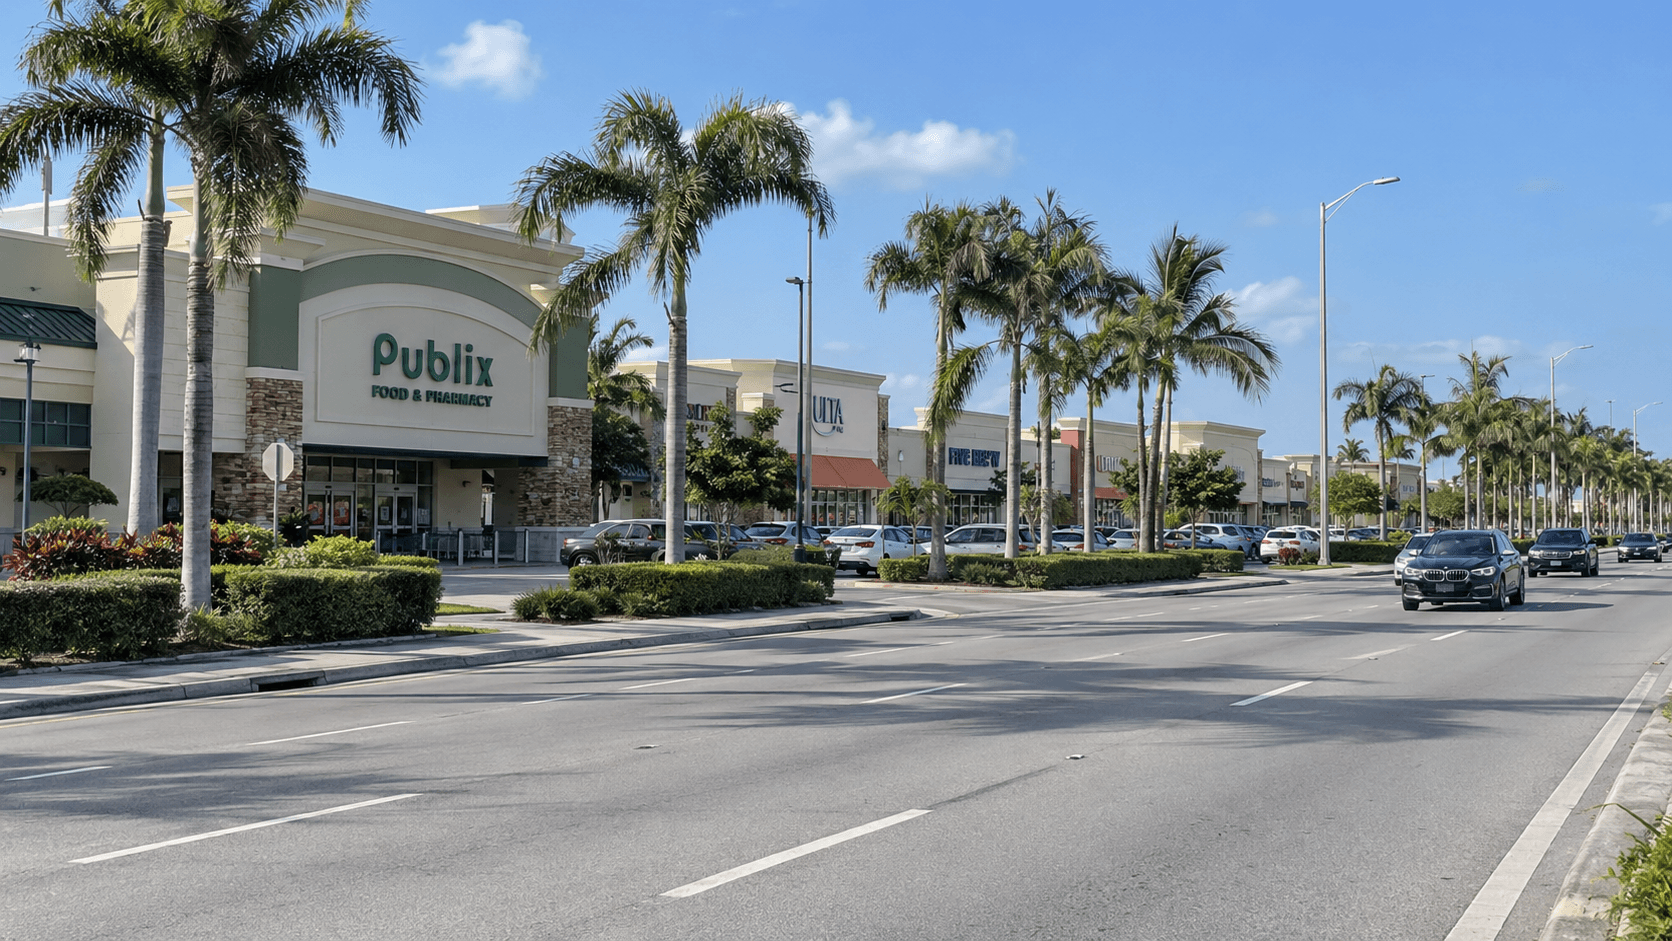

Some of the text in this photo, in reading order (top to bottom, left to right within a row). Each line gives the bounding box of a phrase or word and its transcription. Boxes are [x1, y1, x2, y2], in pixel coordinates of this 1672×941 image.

[373, 333, 493, 386] Publix
[372, 385, 493, 406] FOOD & PHARMACY
[813, 395, 844, 424] ULTA
